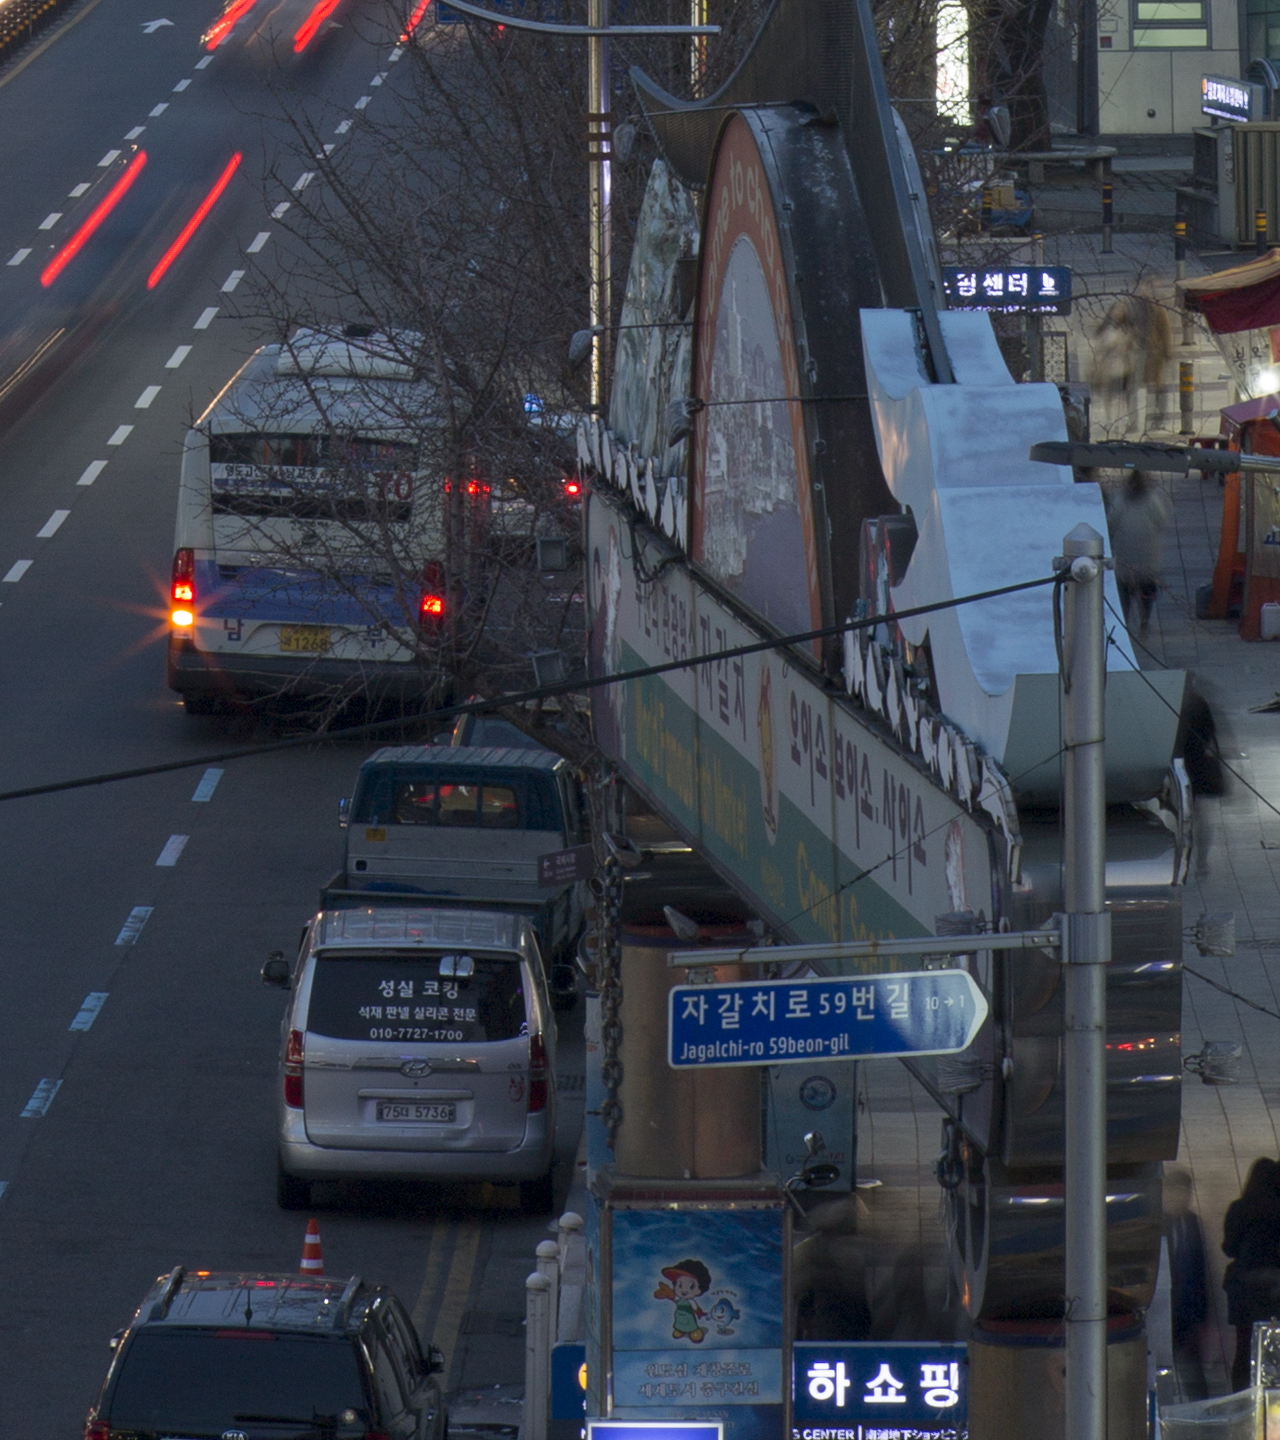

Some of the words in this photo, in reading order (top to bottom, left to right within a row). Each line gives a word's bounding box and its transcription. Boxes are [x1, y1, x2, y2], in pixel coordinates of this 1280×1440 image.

[378, 980, 415, 998] 성실
[422, 980, 459, 999] 코킹
[358, 1006, 382, 1020] 석재
[386, 1006, 409, 1020] 판넬
[414, 1006, 450, 1021] 실리콘
[452, 1008, 477, 1022] 전문
[681, 982, 911, 1029] 자갈치로59번길
[925, 996, 939, 1010] 10
[370, 1028, 463, 1041] 010-7727-1700
[680, 1034, 765, 1061] Jagalchi-ro
[769, 1032, 850, 1057] 59beon-gil
[414, 1105, 448, 1119] 5736
[807, 1360, 959, 1408] 하쇼핑
